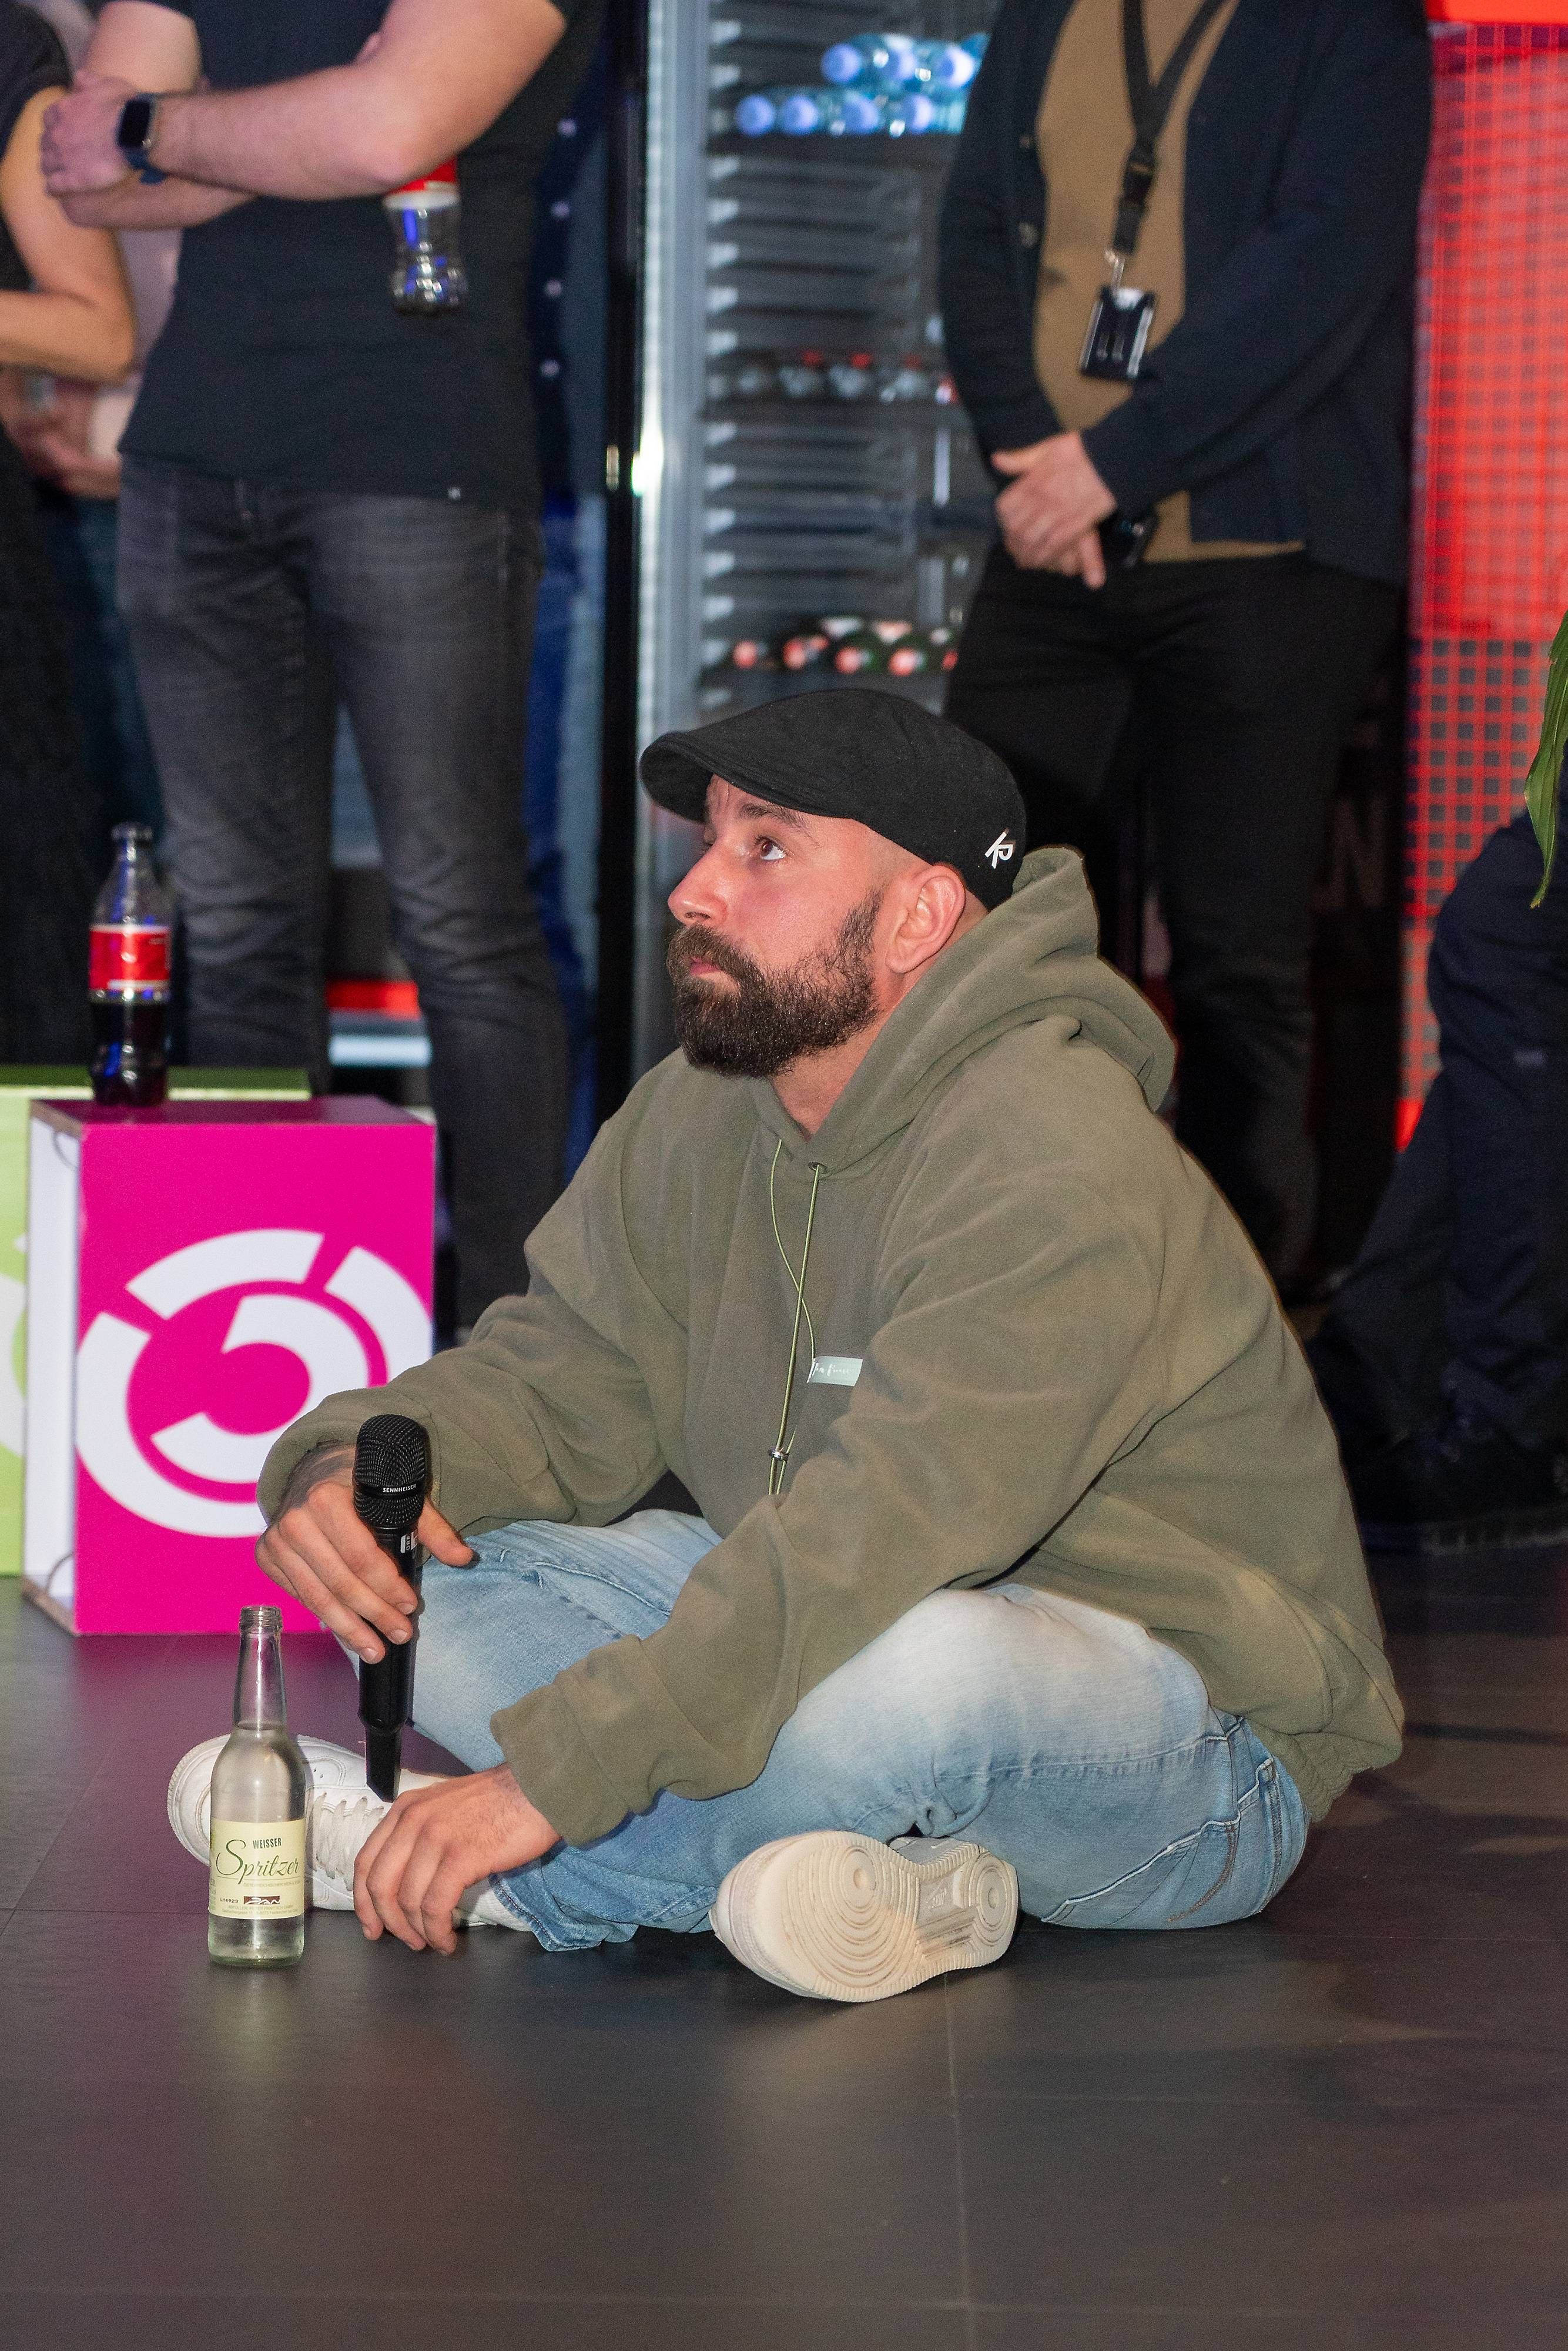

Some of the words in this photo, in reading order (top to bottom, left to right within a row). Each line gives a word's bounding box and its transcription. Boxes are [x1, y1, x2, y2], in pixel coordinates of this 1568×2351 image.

[383, 1483, 416, 1493] SENNHEISER
[252, 1837, 282, 1849] WEISSER
[216, 1840, 299, 1885] Spritzer
